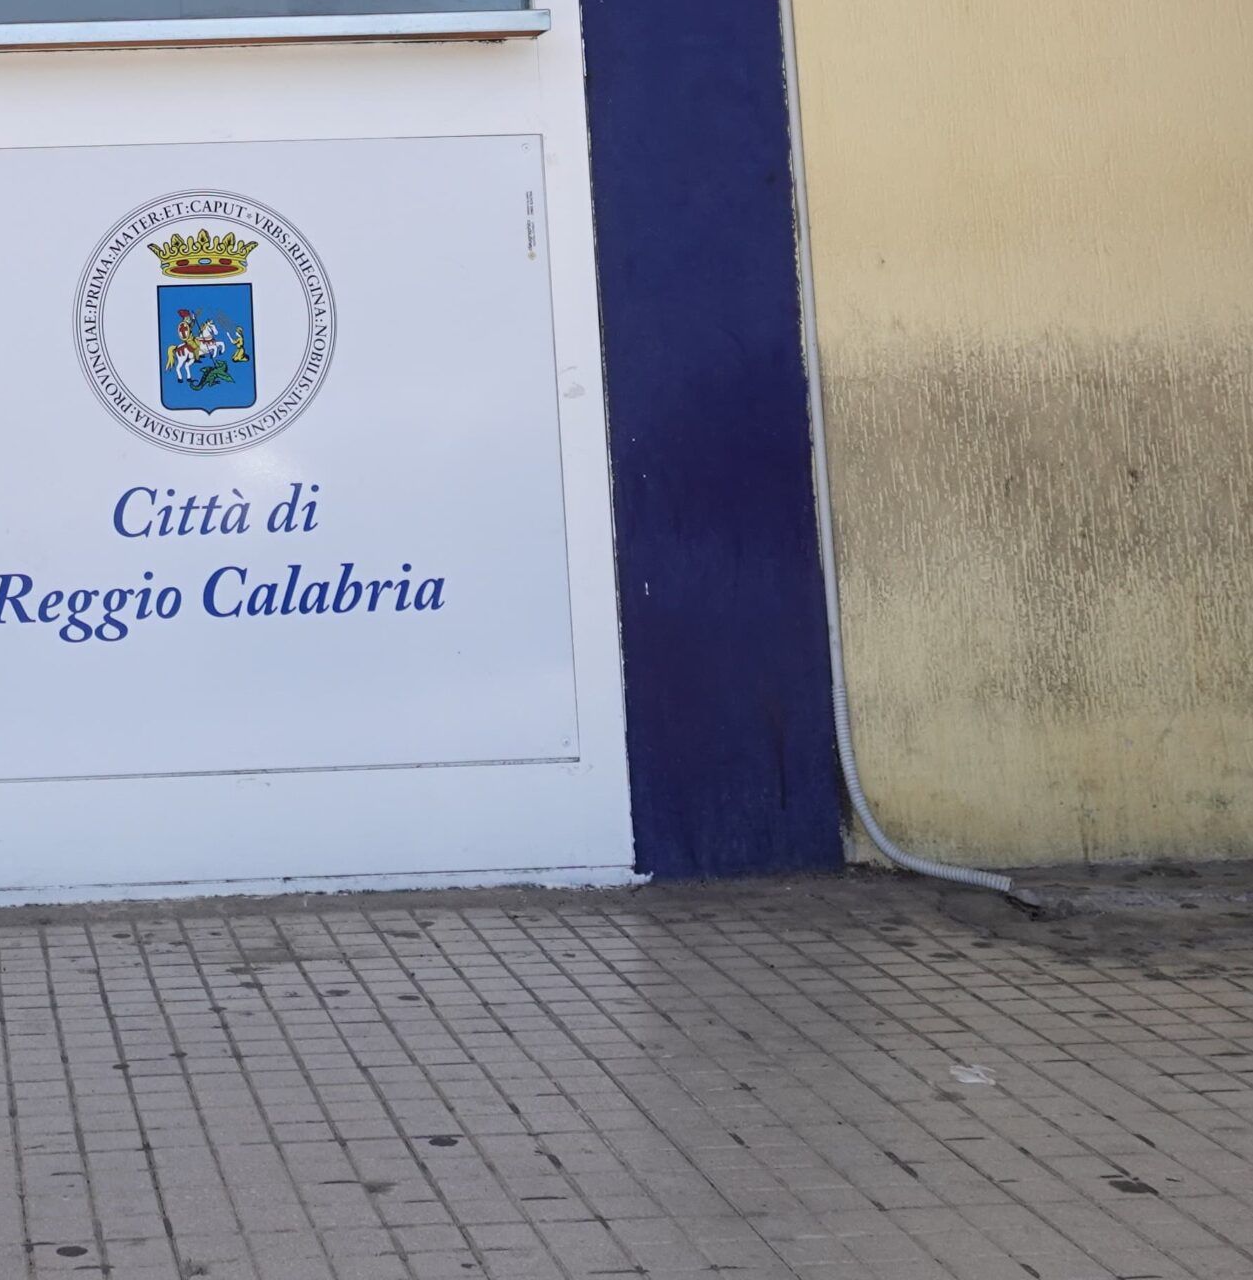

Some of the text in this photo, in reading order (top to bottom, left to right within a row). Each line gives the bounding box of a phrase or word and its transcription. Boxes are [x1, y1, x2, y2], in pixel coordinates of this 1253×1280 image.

[189, 200, 248, 218] CAPUT
[113, 482, 320, 538] Città di
[202, 562, 445, 618] Calabria
